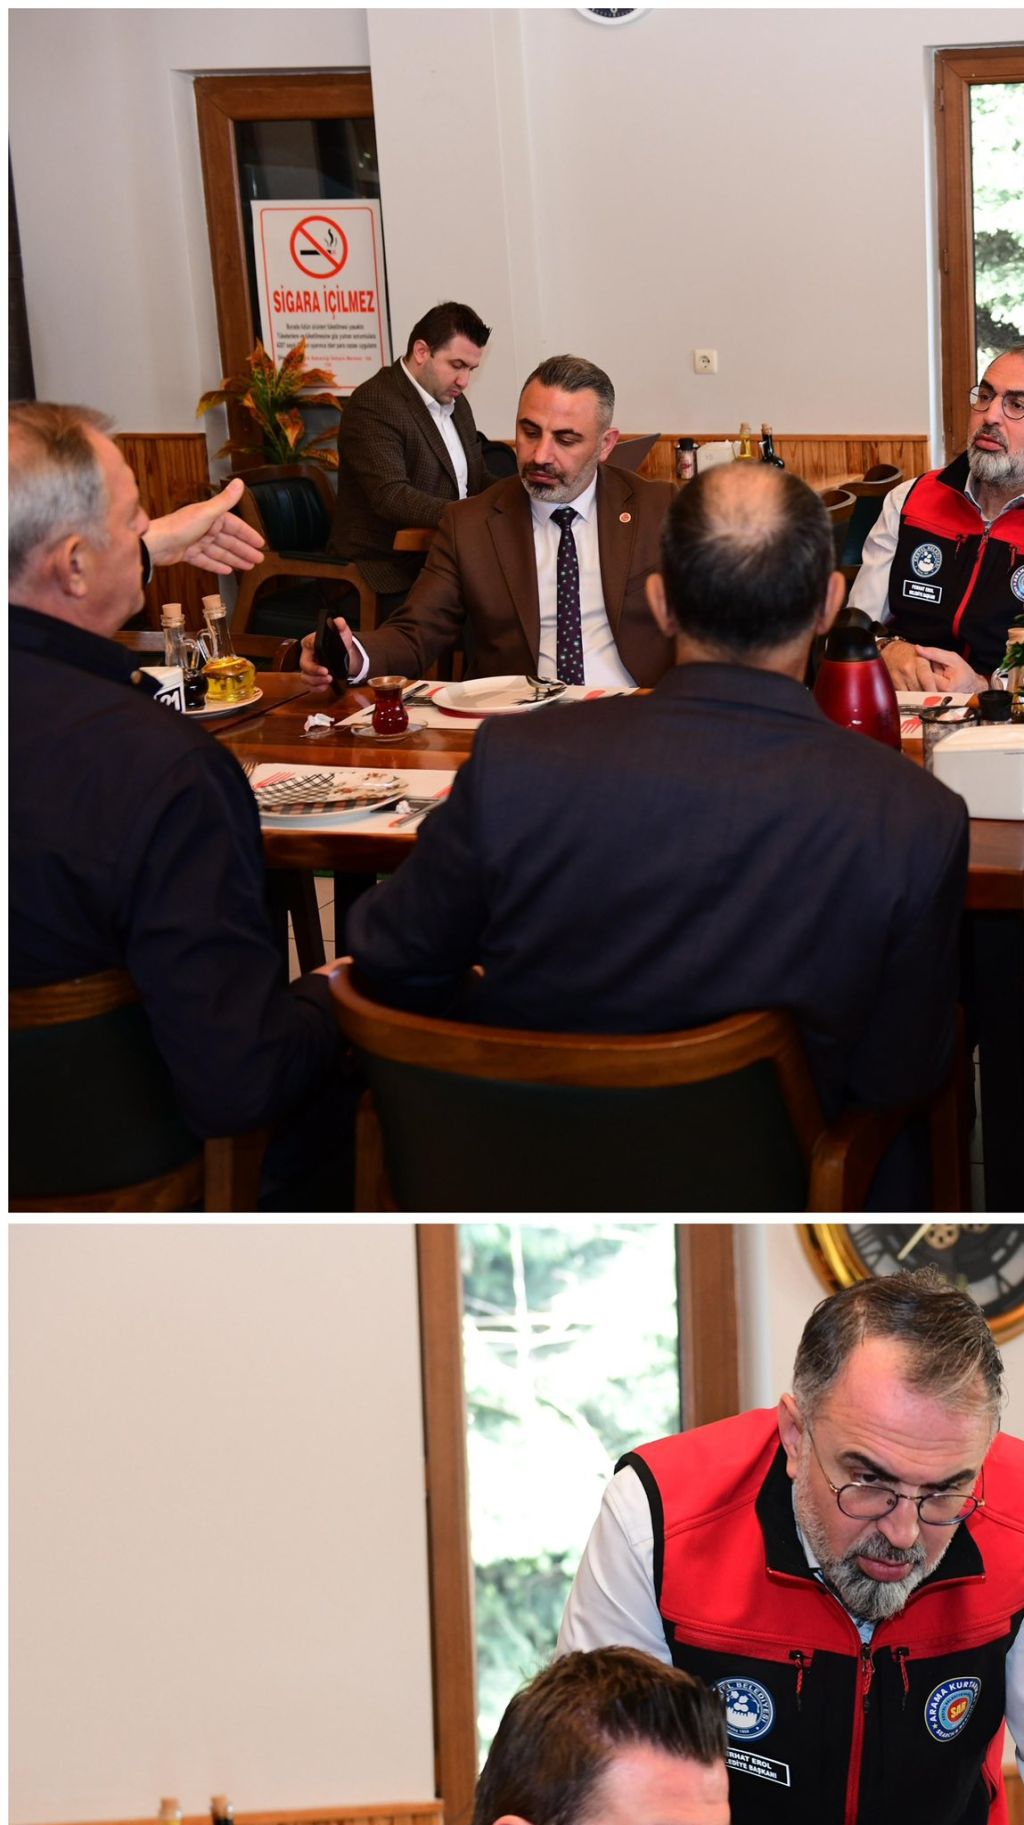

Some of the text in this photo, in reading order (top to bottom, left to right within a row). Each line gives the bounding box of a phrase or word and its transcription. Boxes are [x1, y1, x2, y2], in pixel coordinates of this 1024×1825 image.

[273, 285, 375, 320] SİGARA İÇİLMEZ
[929, 1688, 948, 1722] ARAMA
[752, 1757, 772, 1770] EROL
